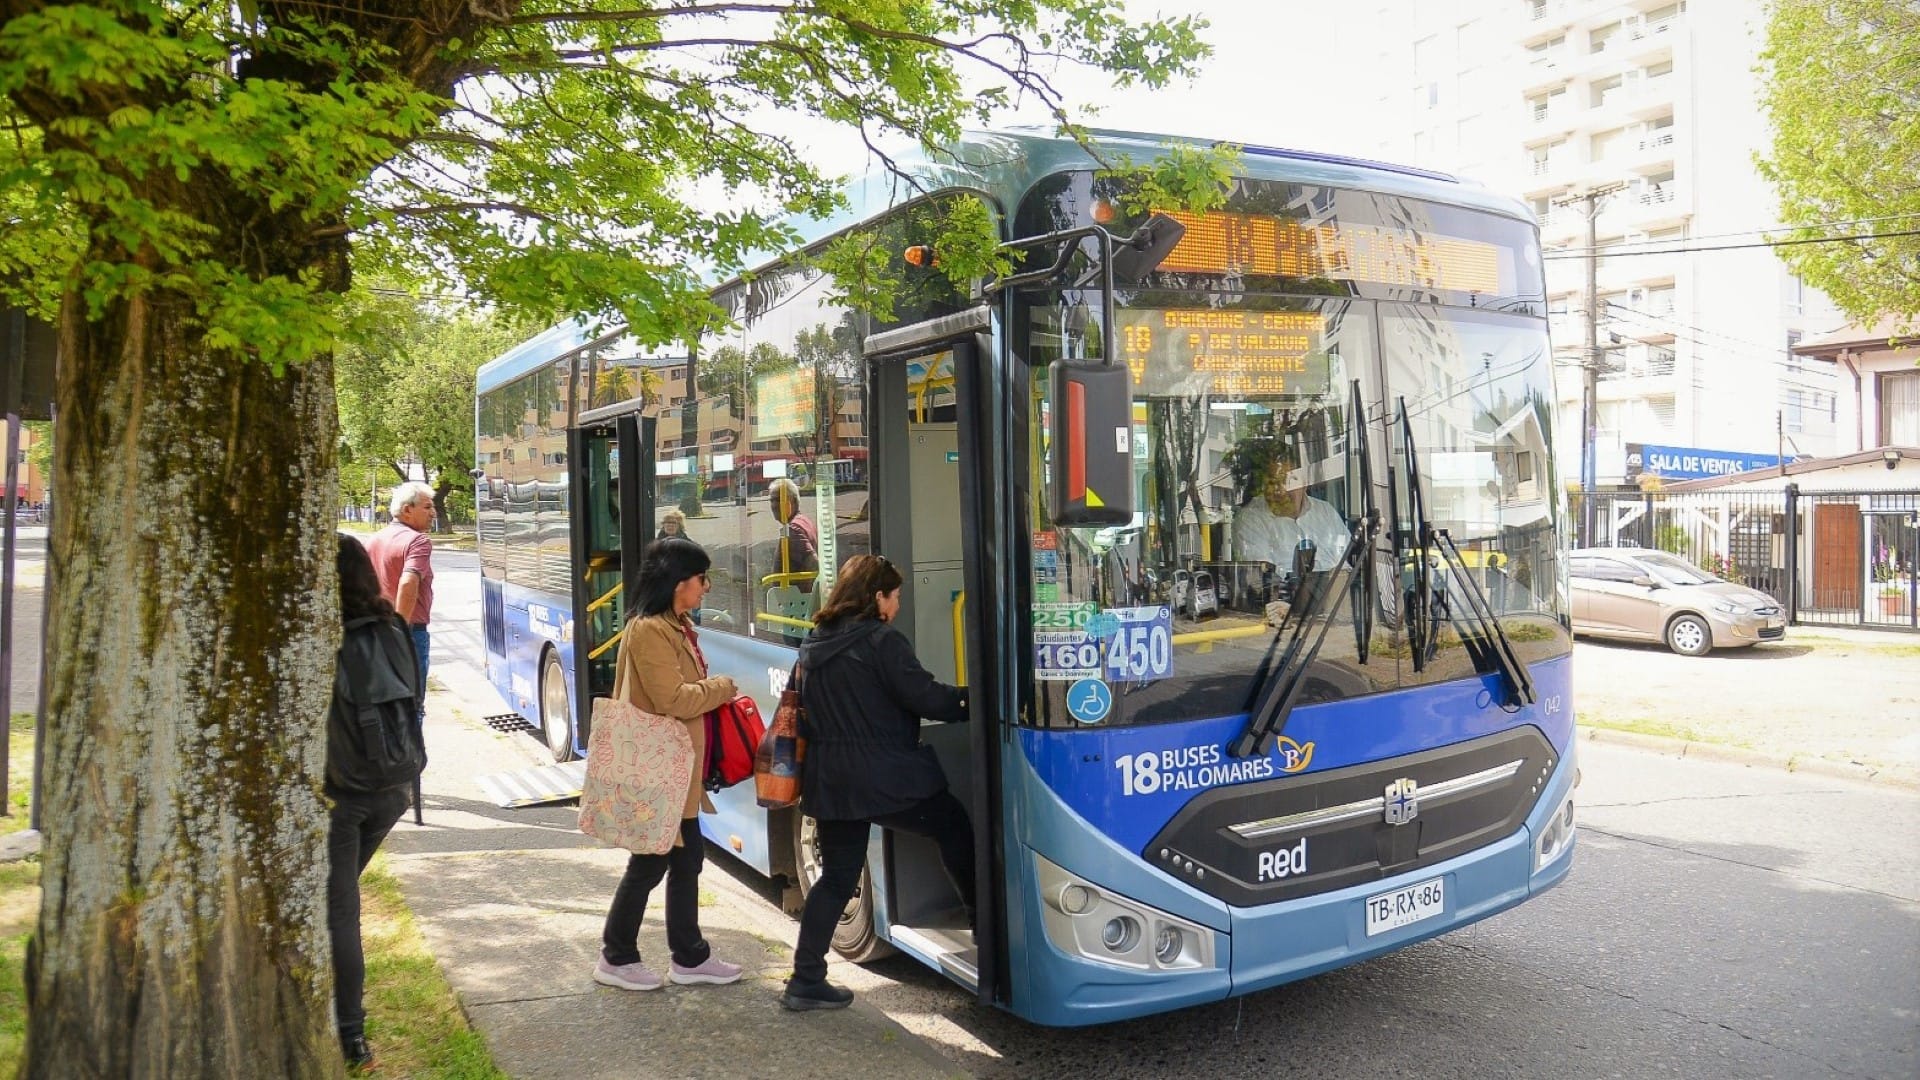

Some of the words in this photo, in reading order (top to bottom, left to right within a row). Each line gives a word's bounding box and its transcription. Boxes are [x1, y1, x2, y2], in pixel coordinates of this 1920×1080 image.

[1263, 314, 1326, 331] CENTRO
[1124, 325, 1151, 352] 18
[1209, 333, 1233, 350] DE
[1235, 334, 1309, 351] VALDIVIA
[1214, 375, 1285, 393] HUALQUI
[1650, 453, 1681, 471] SALA
[1682, 455, 1699, 472] DE
[1699, 456, 1743, 474] VENTAS
[1033, 611, 1094, 627] 250
[1035, 634, 1082, 643] Estudiantes
[1038, 644, 1098, 668] 160
[1108, 625, 1168, 677] 450
[1545, 695, 1560, 715] 042
[1162, 744, 1220, 770] BUSES
[1115, 751, 1161, 796] 18
[1162, 757, 1274, 792] PALOMARES
